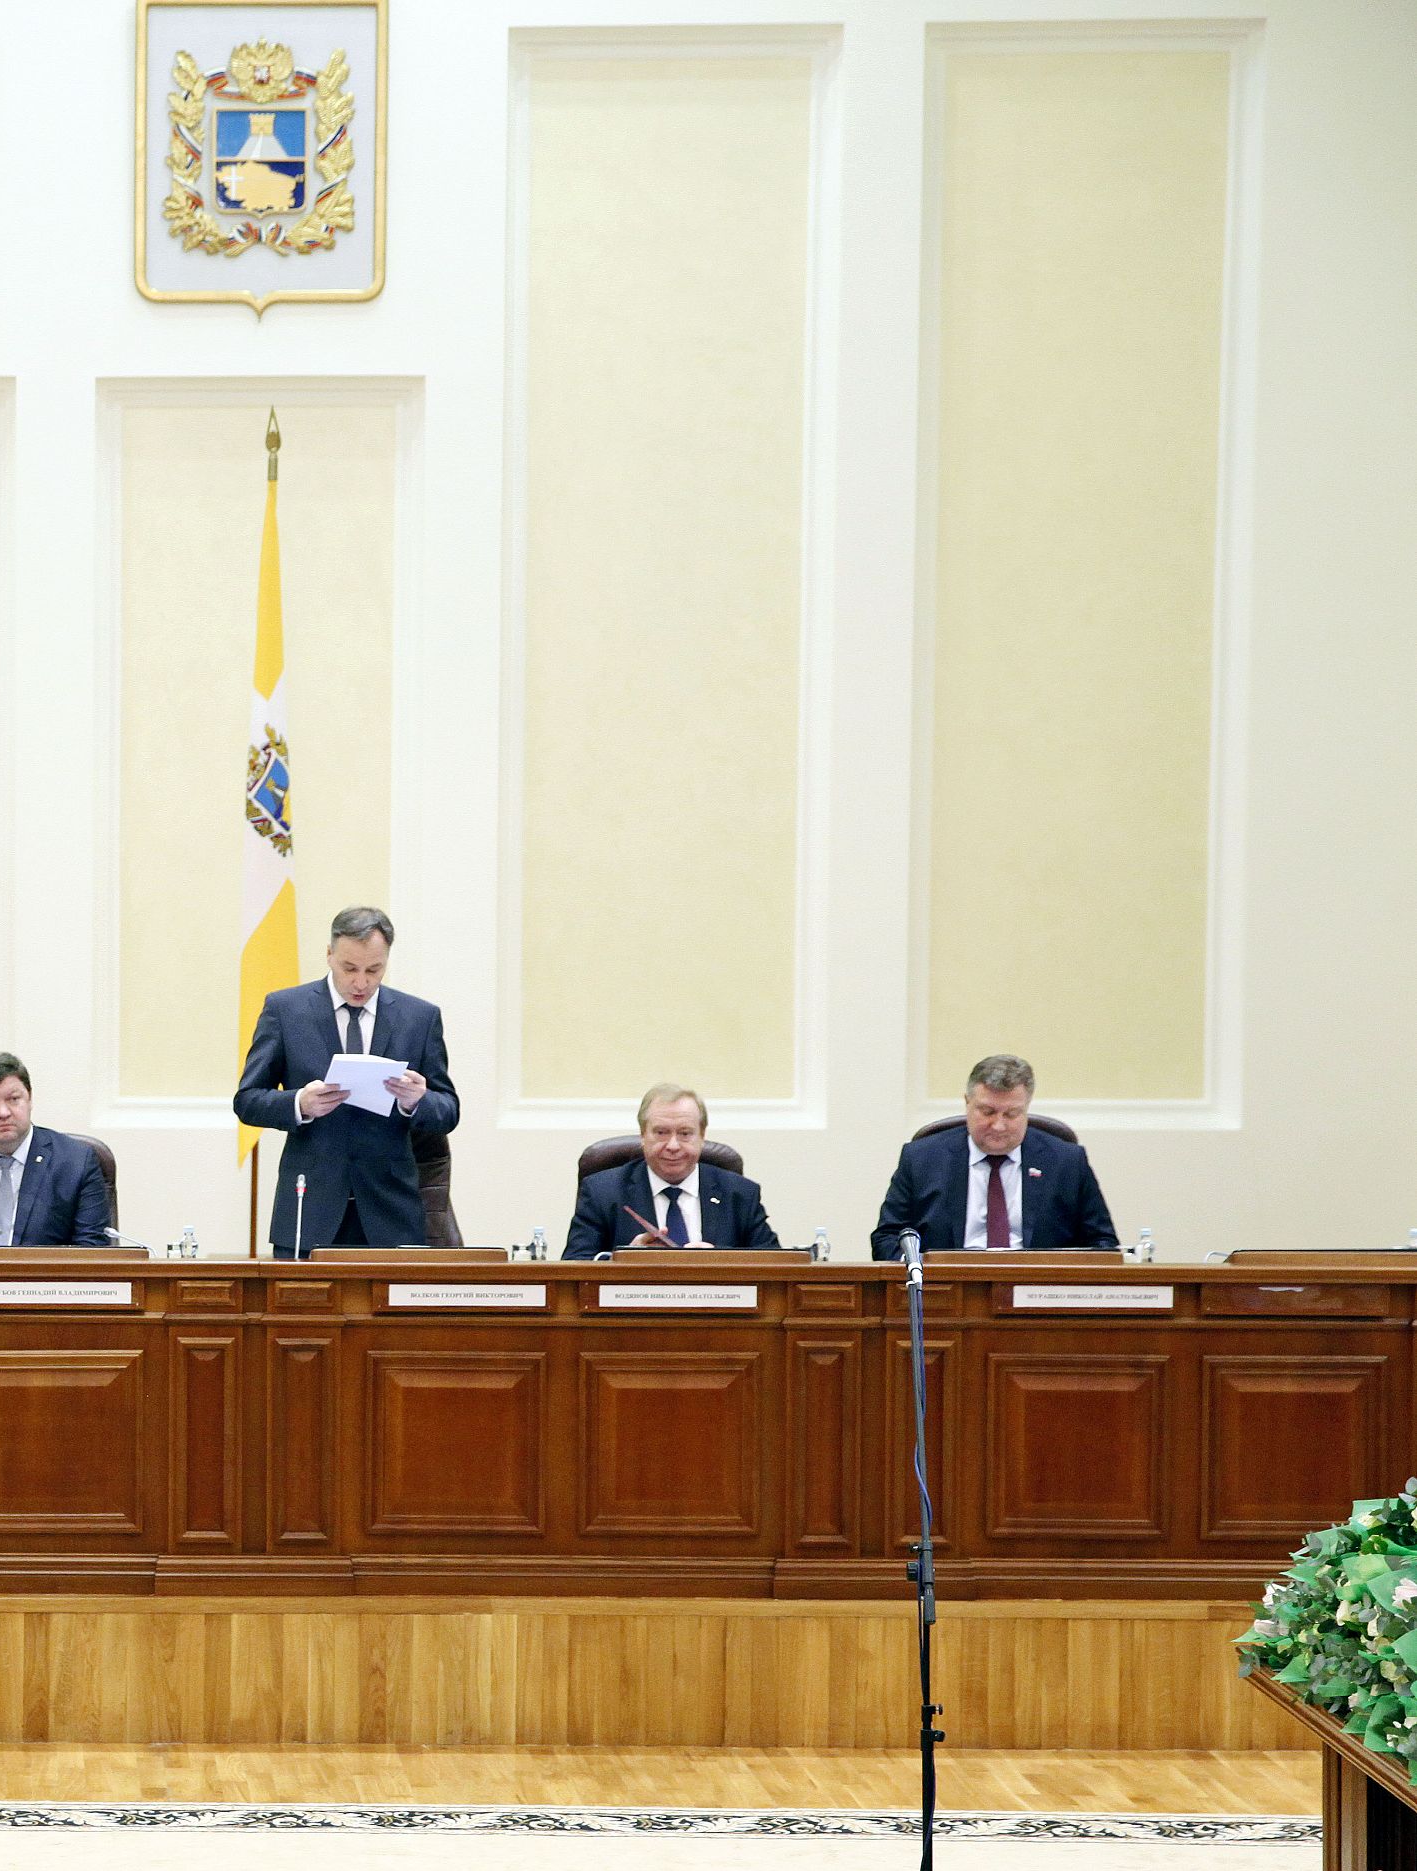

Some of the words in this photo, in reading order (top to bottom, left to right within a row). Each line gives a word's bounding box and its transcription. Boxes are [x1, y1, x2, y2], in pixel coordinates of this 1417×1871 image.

[440, 1291, 474, 1299] ГЕОРГИЙ
[650, 1292, 687, 1300] НИКОЛАЙ
[1067, 1292, 1103, 1300] НИКОЛАЙ
